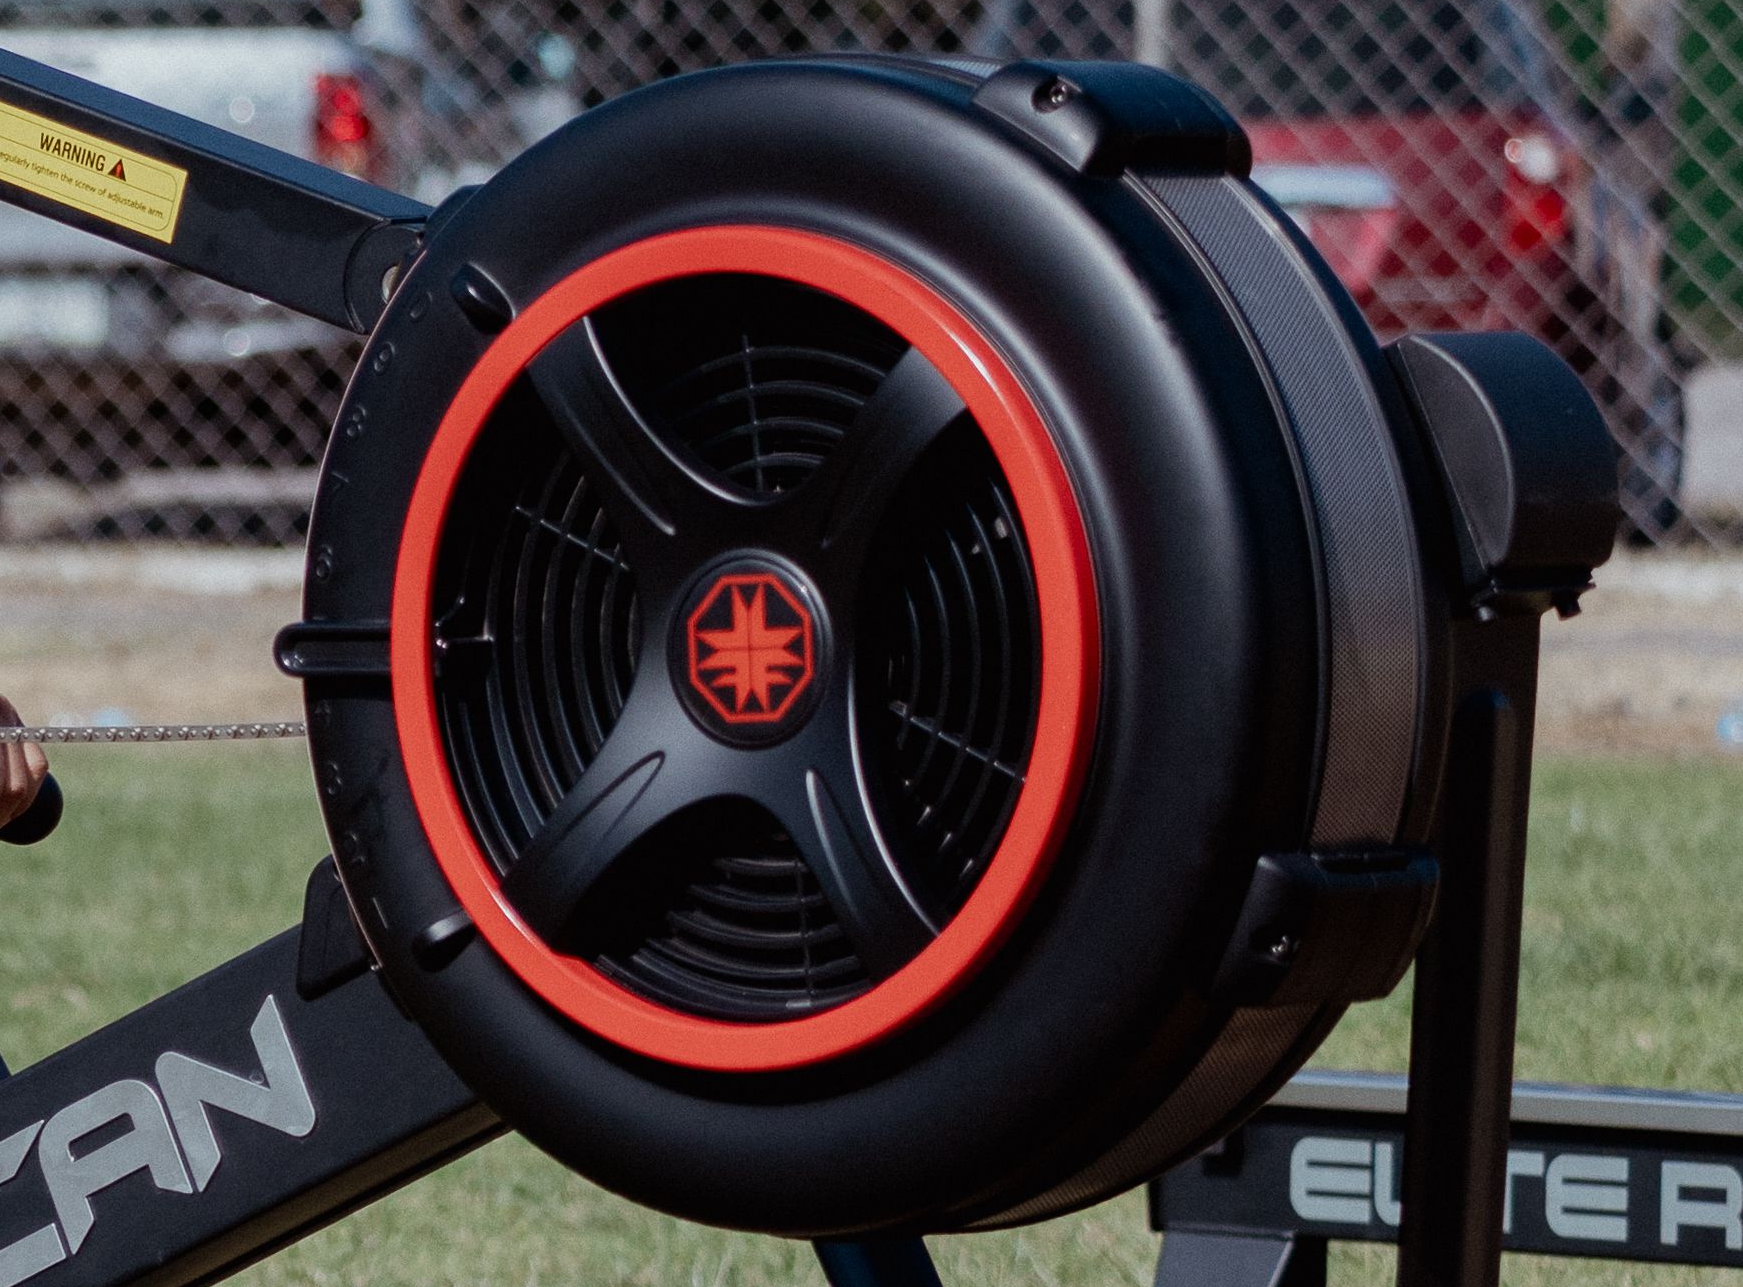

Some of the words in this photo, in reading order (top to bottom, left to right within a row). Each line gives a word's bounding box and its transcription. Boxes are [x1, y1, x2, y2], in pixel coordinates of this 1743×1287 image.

[40, 132, 106, 172] WARNING
[31, 161, 59, 178] tighten
[60, 173, 73, 185] the
[75, 179, 96, 194] screw
[97, 187, 107, 197] of
[107, 193, 147, 212] adjustable
[1289, 1136, 1629, 1243] ELTE
